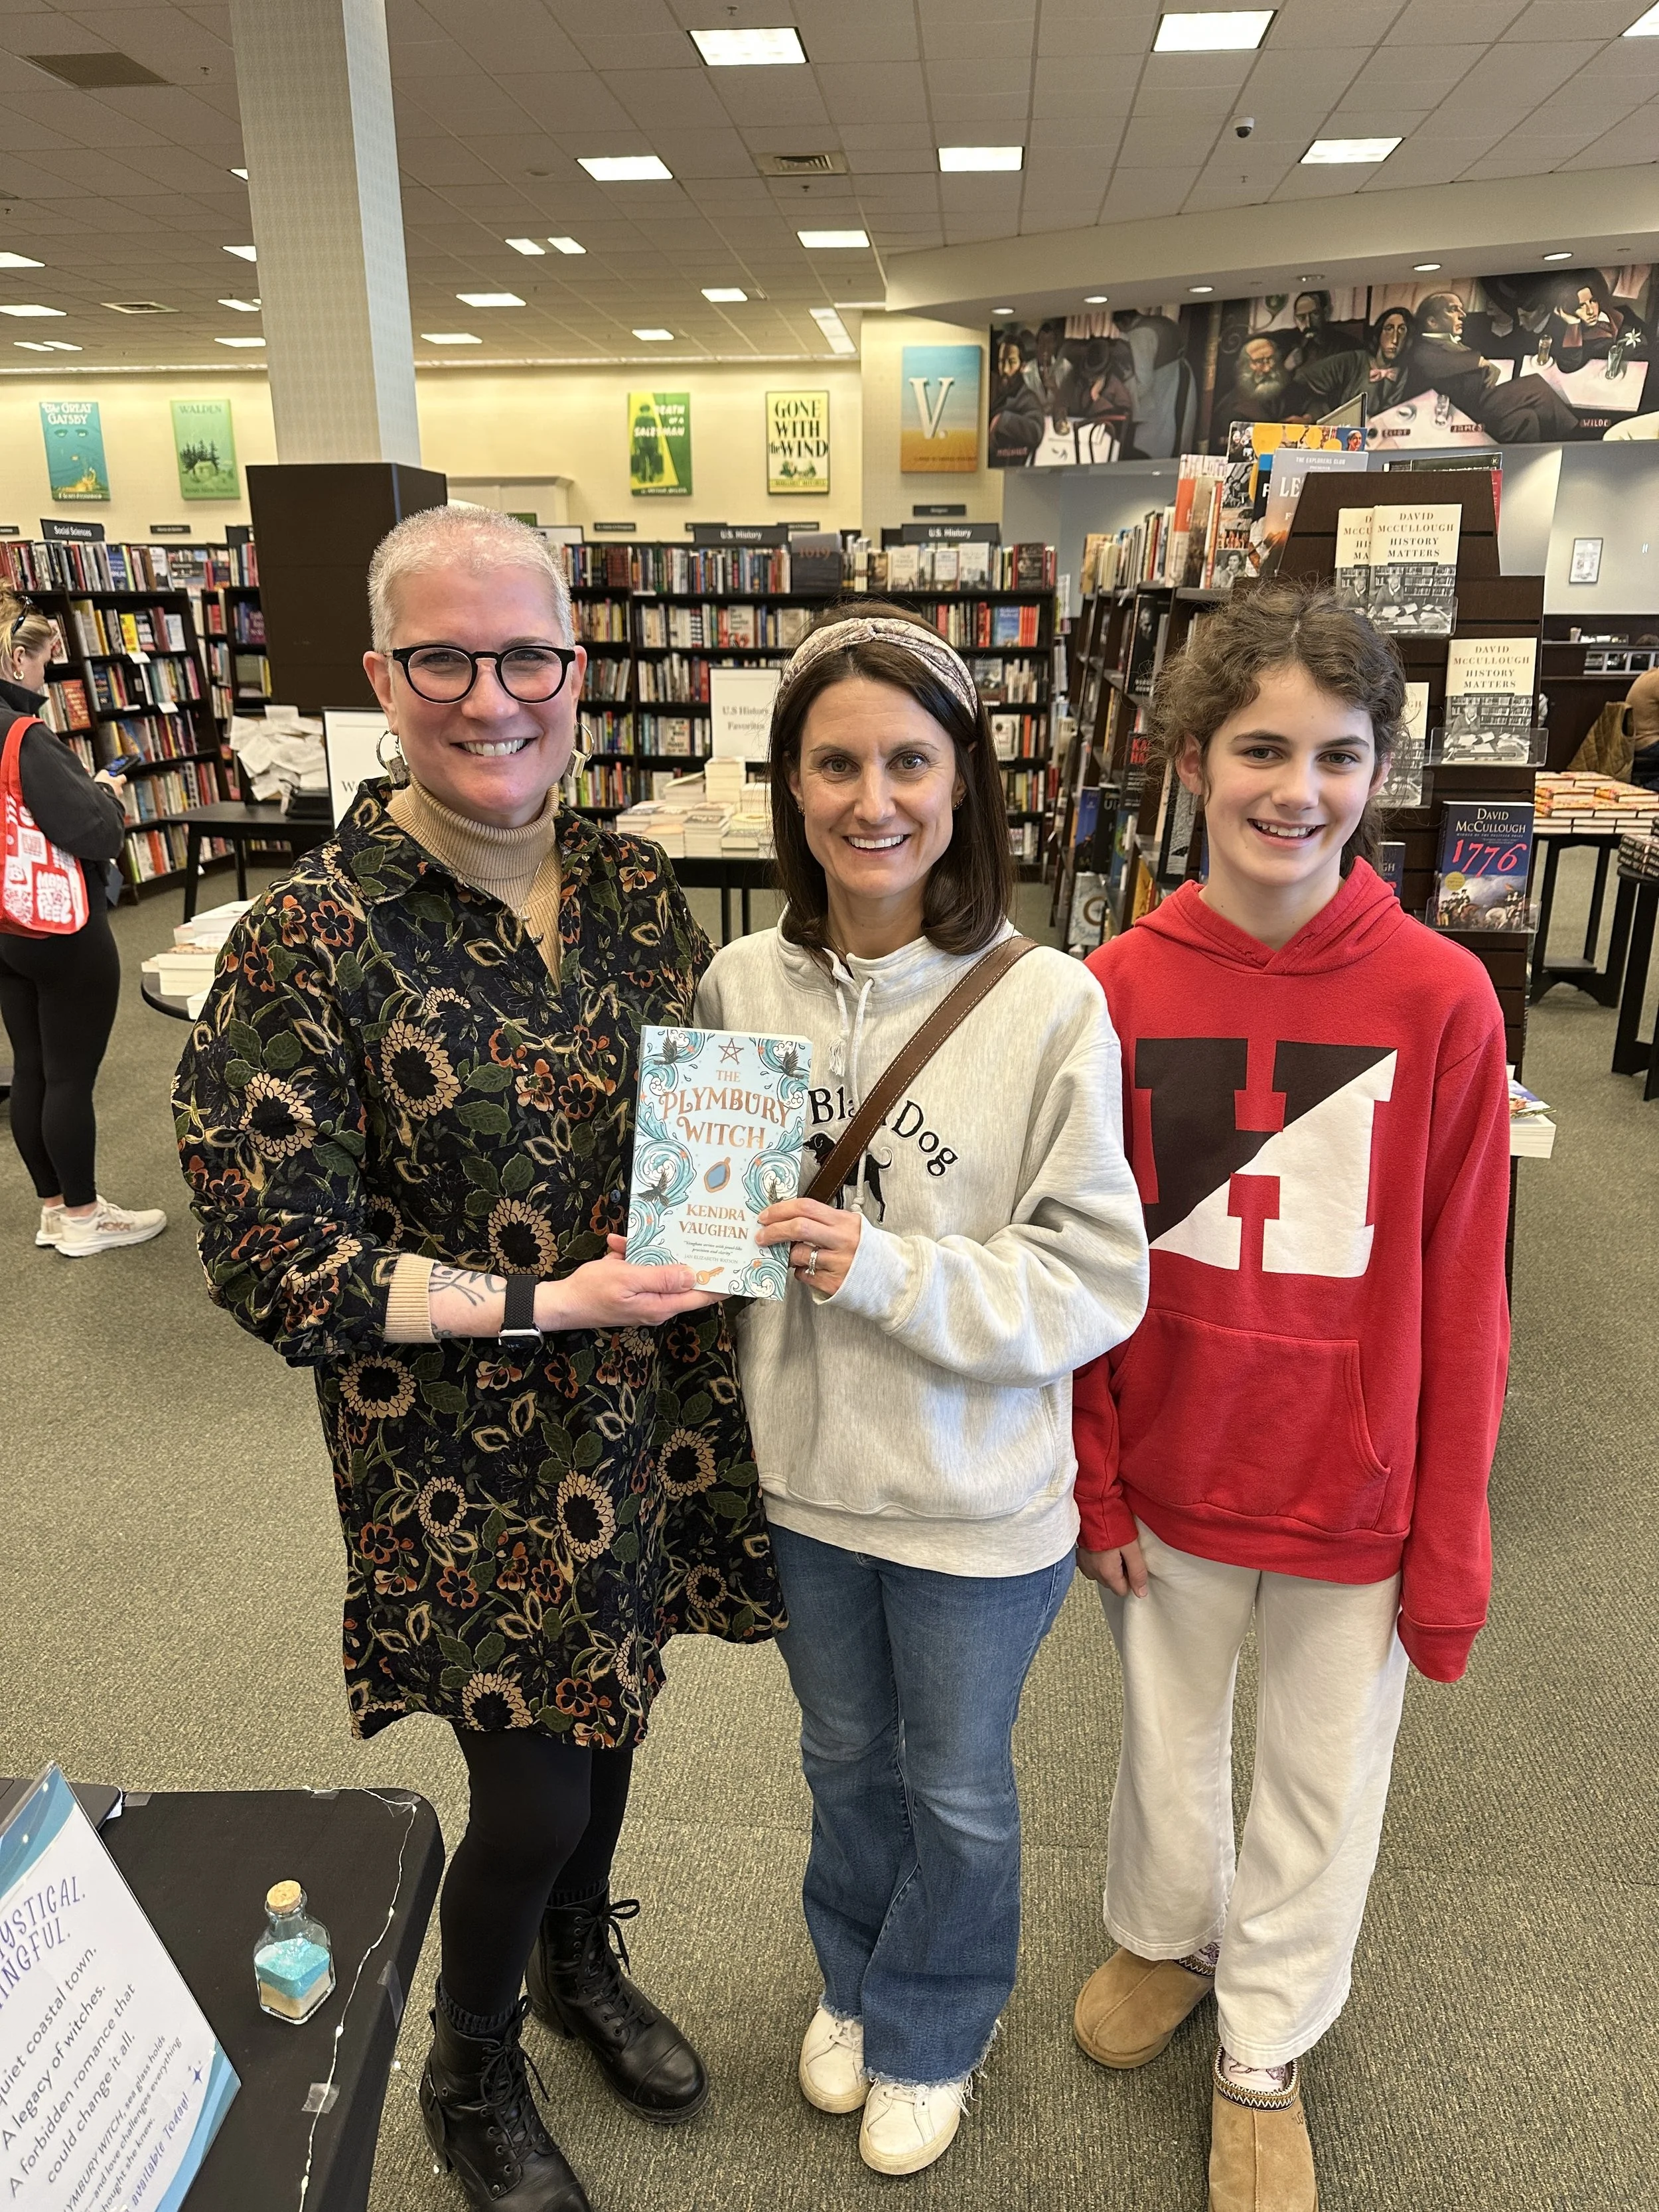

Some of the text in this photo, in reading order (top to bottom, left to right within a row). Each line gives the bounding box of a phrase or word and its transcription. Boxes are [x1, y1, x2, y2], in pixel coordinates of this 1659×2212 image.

[61, 402, 92, 413] GREAT
[179, 405, 222, 414] WALDEN
[655, 405, 685, 415] DEATH
[774, 400, 822, 418] GONE
[48, 413, 88, 425] GATSBY
[634, 427, 685, 437] SALESMAN
[775, 420, 820, 438] WITH
[768, 440, 829, 458] the WIND
[1400, 512, 1434, 521] DAVID
[54, 526, 69, 536] Social
[735, 530, 762, 542] History
[944, 528, 972, 539] History
[1378, 524, 1455, 533] McCULLOUGH
[1390, 538, 1439, 546] HISTORY
[1453, 656, 1530, 665] McCULLOUGH
[739, 705, 768, 715] History
[727, 721, 765, 731] Favorites
[1452, 839, 1527, 878] 1776
[715, 1069, 741, 1082] THE
[658, 1086, 792, 1128] PLYMBURY
[676, 1116, 766, 1149] WITCH
[891, 1100, 958, 1177] Dog
[1134, 1037, 1398, 1278] H
[686, 1204, 746, 1221] KENDRA
[96, 1220, 131, 1231] HOKA
[679, 1220, 749, 1240] VAUGHAN
[0, 1876, 86, 1958] YSTICAL.
[0, 1917, 71, 2009] INGFUL.
[27, 1986, 67, 2054] coastal
[64, 1948, 97, 1992] town.
[2, 1986, 106, 2151] A legacy of witches.
[9, 1983, 135, 2198] A forbidden romance that
[48, 2030, 135, 2183] could change it all.
[106, 2150, 121, 2175] love
[119, 2093, 152, 2150] challenges
[150, 2036, 182, 2093] everything
[64, 2035, 167, 2212] YMBURY WITCH, sea glass holds
[162, 2091, 190, 2140] Today!
[99, 2170, 127, 2212] hought
[125, 2150, 138, 2170] she
[136, 2118, 155, 2148] knew.
